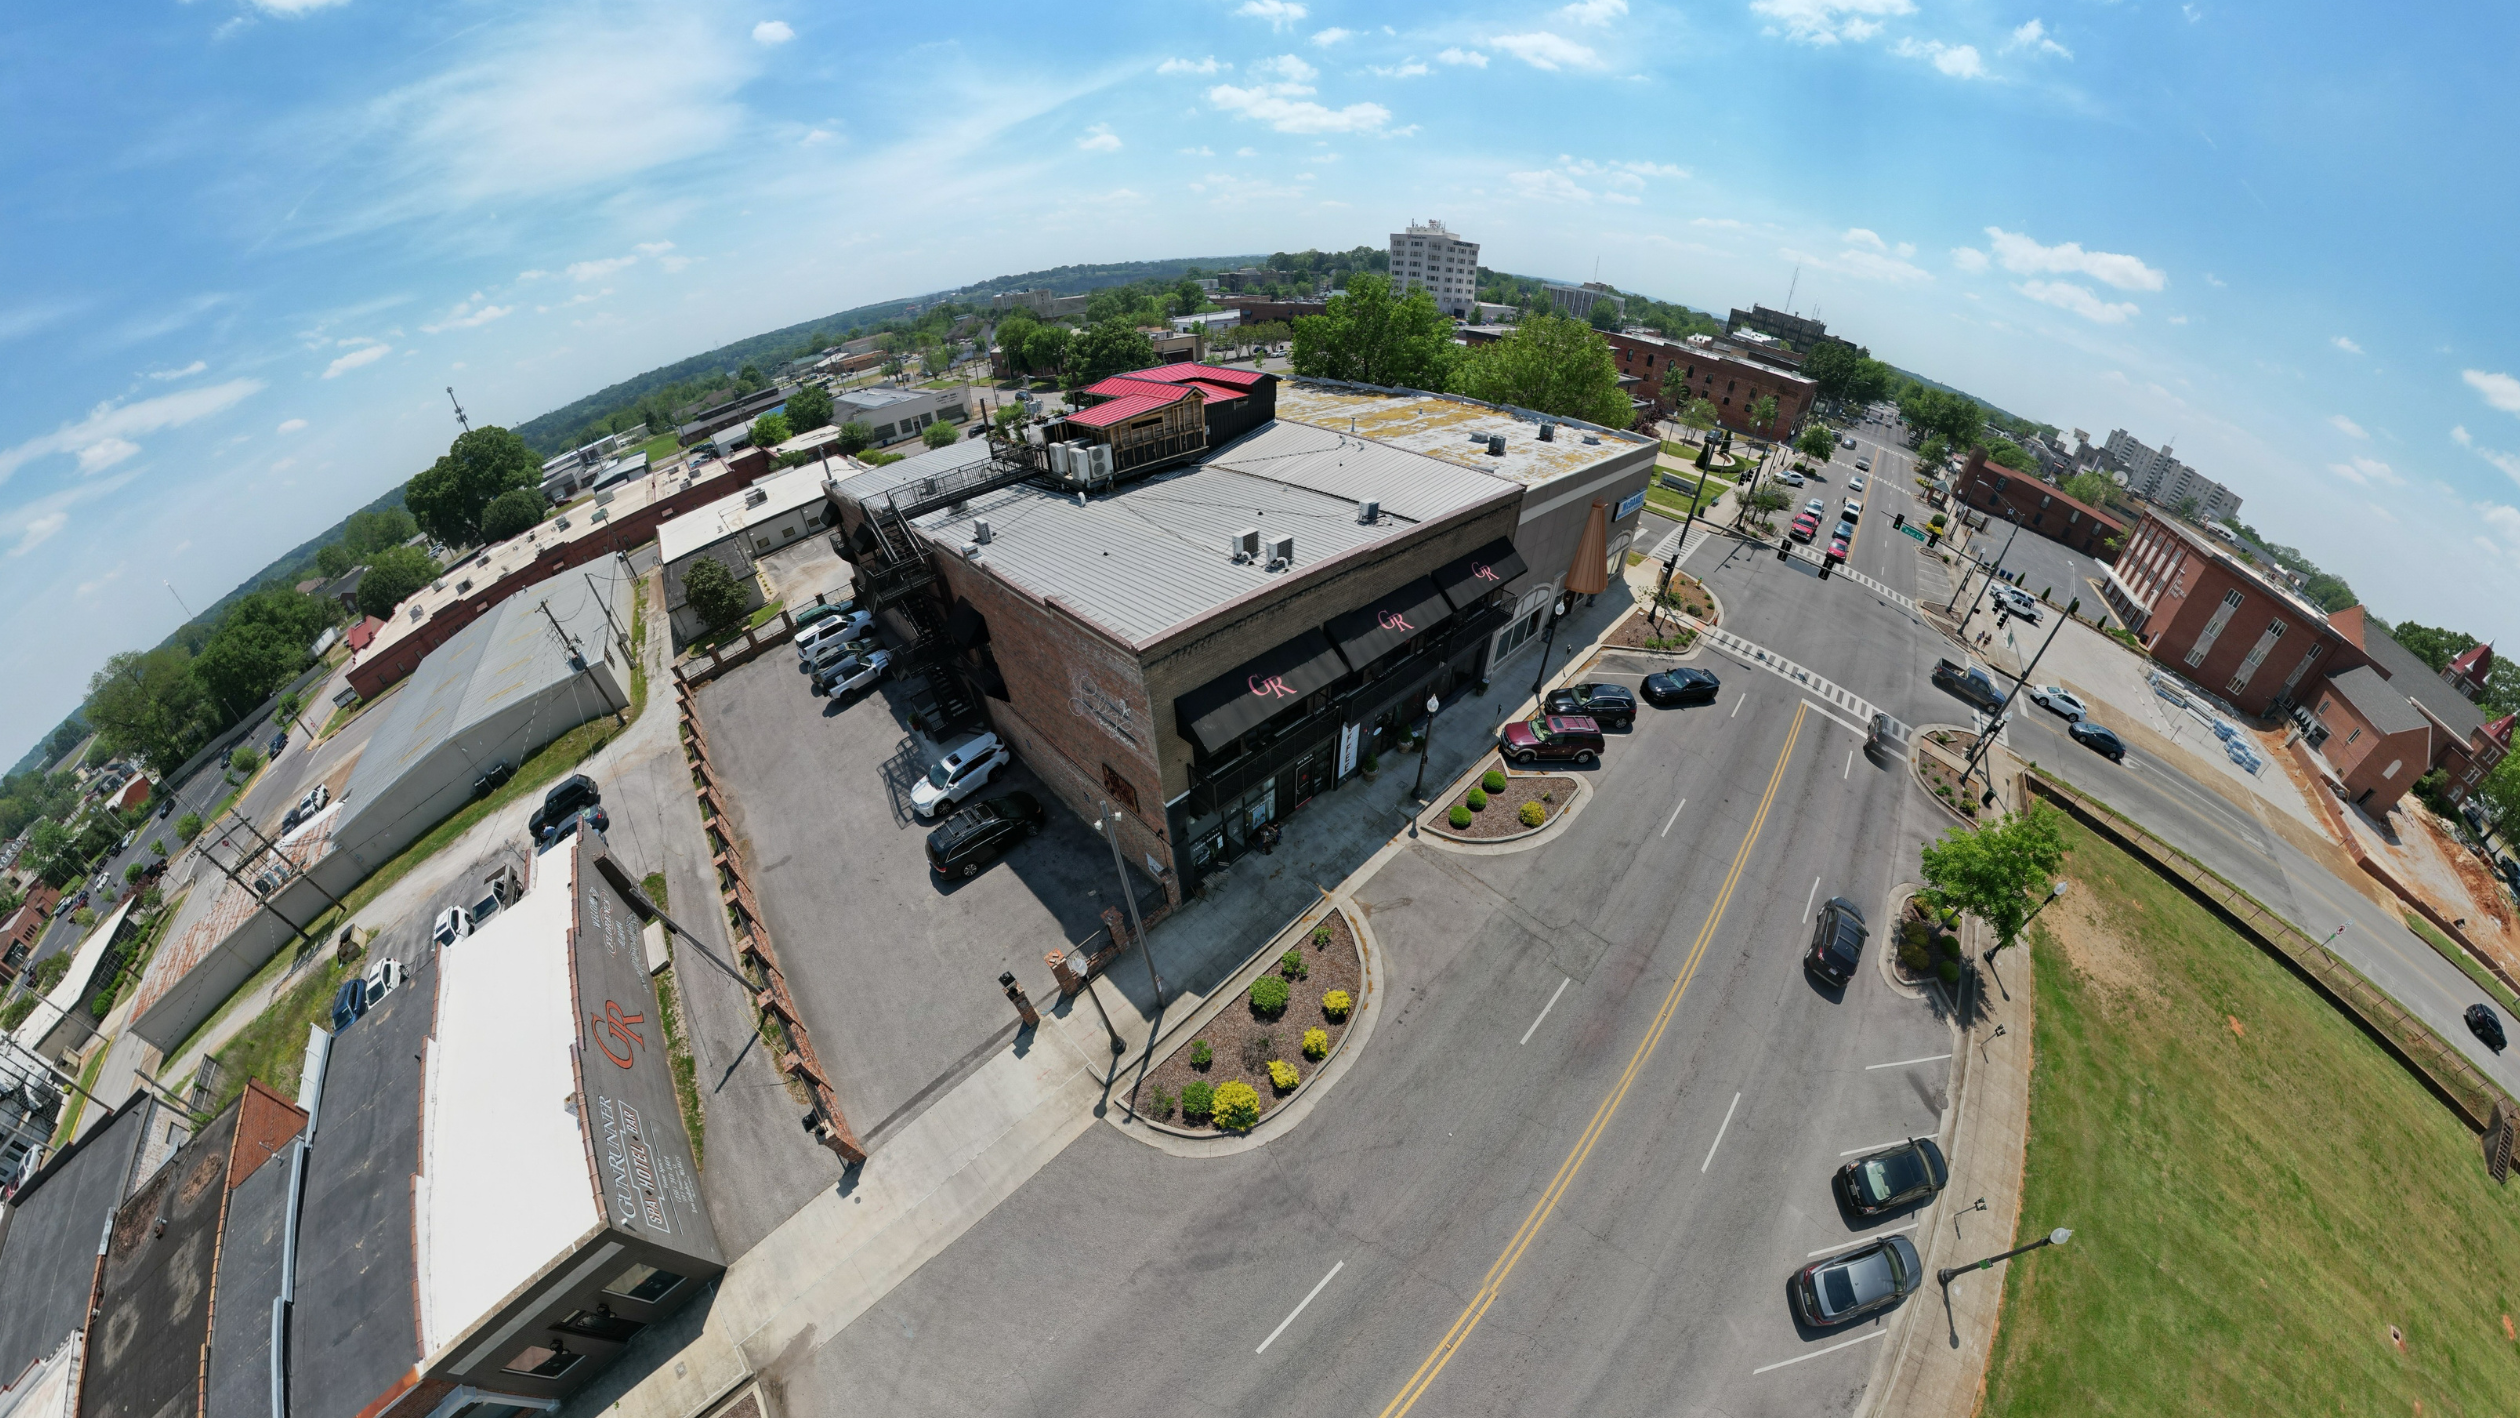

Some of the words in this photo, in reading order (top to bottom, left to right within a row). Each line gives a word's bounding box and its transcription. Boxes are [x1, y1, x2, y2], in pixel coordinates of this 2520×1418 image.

[1471, 561, 1500, 582] GR
[1377, 609, 1415, 633] GR
[1248, 673, 1297, 699] GR
[591, 1000, 646, 1069] GR
[623, 1110, 639, 1135] BAR
[630, 1144, 655, 1191] HOTEL
[645, 1199, 662, 1225] SPA
